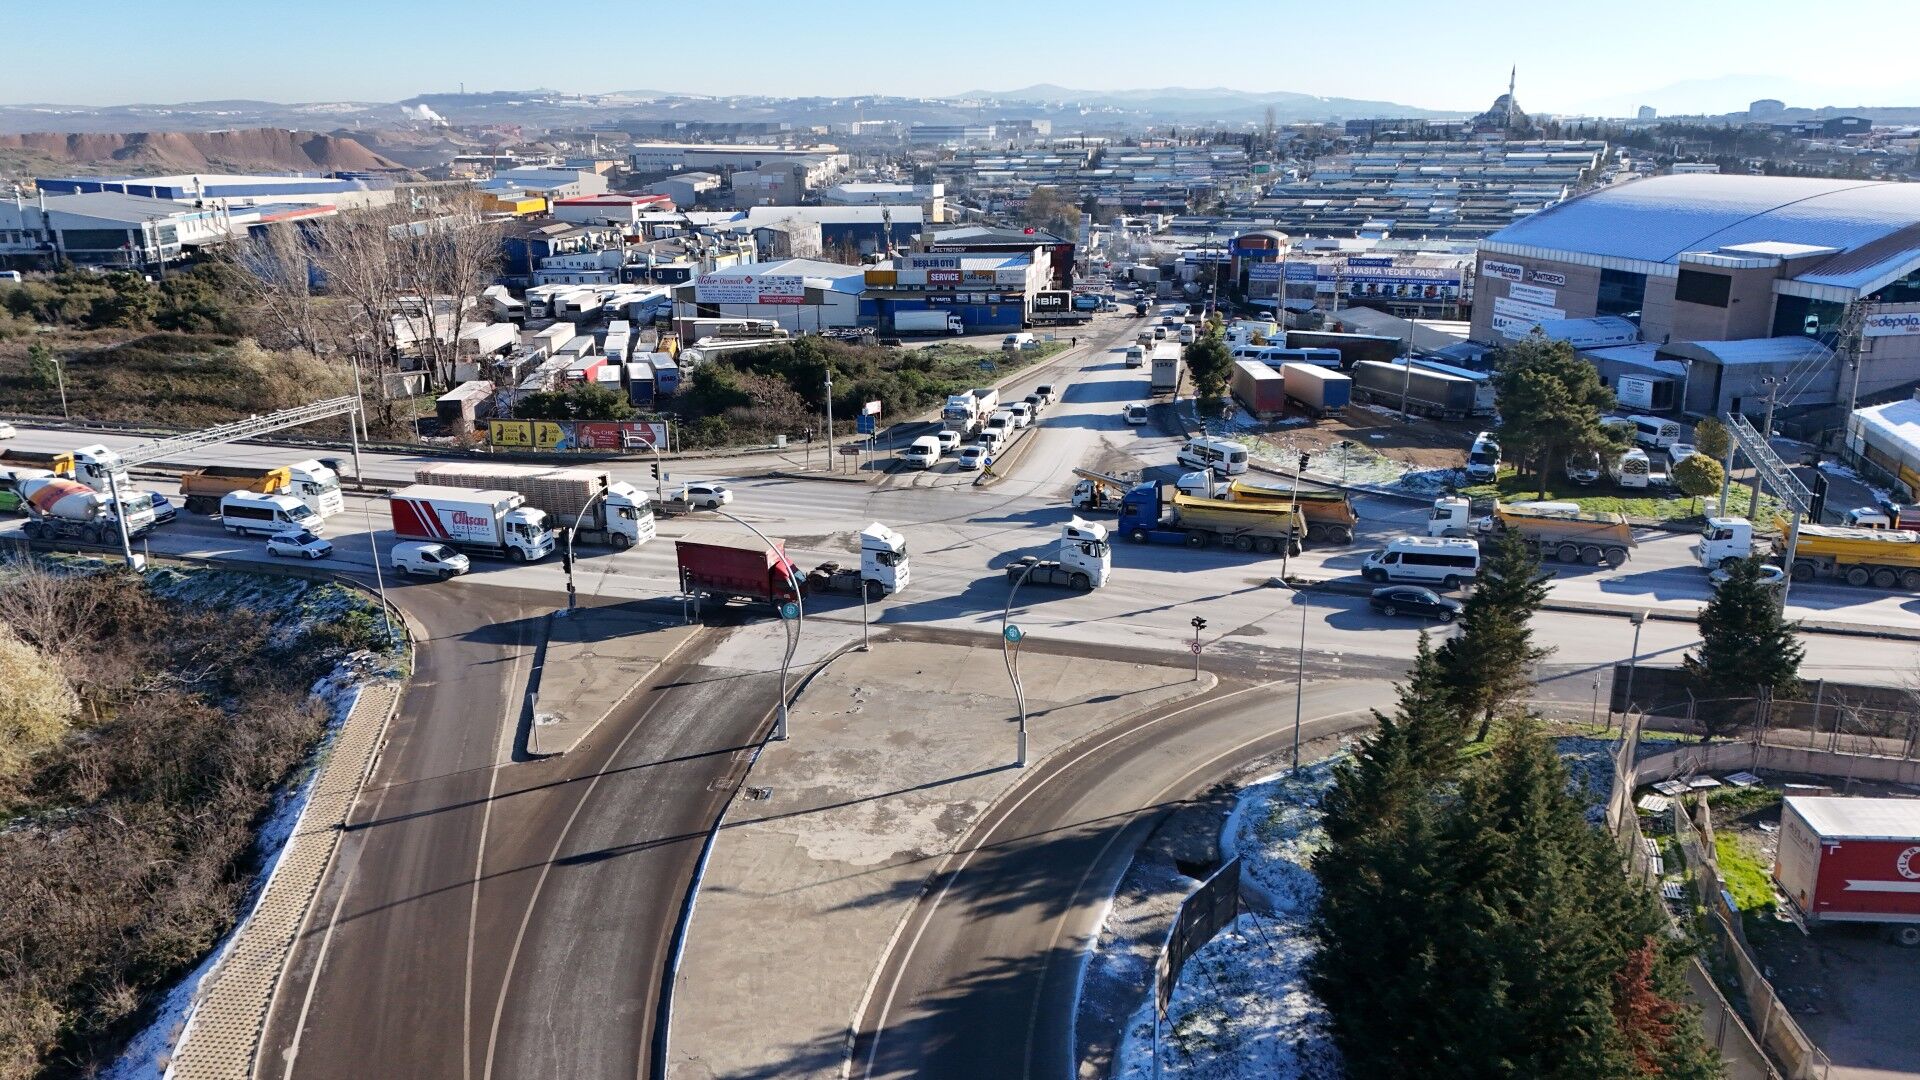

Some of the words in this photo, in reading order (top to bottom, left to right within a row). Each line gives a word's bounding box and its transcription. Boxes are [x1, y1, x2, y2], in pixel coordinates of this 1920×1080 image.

[912, 259, 939, 269] BEŞLER
[940, 259, 954, 267] OTO
[930, 272, 960, 281] SERVICE
[1353, 266, 1382, 275] VASITA
[1384, 268, 1412, 276] YEDEK
[1415, 269, 1444, 278] PARÇA
